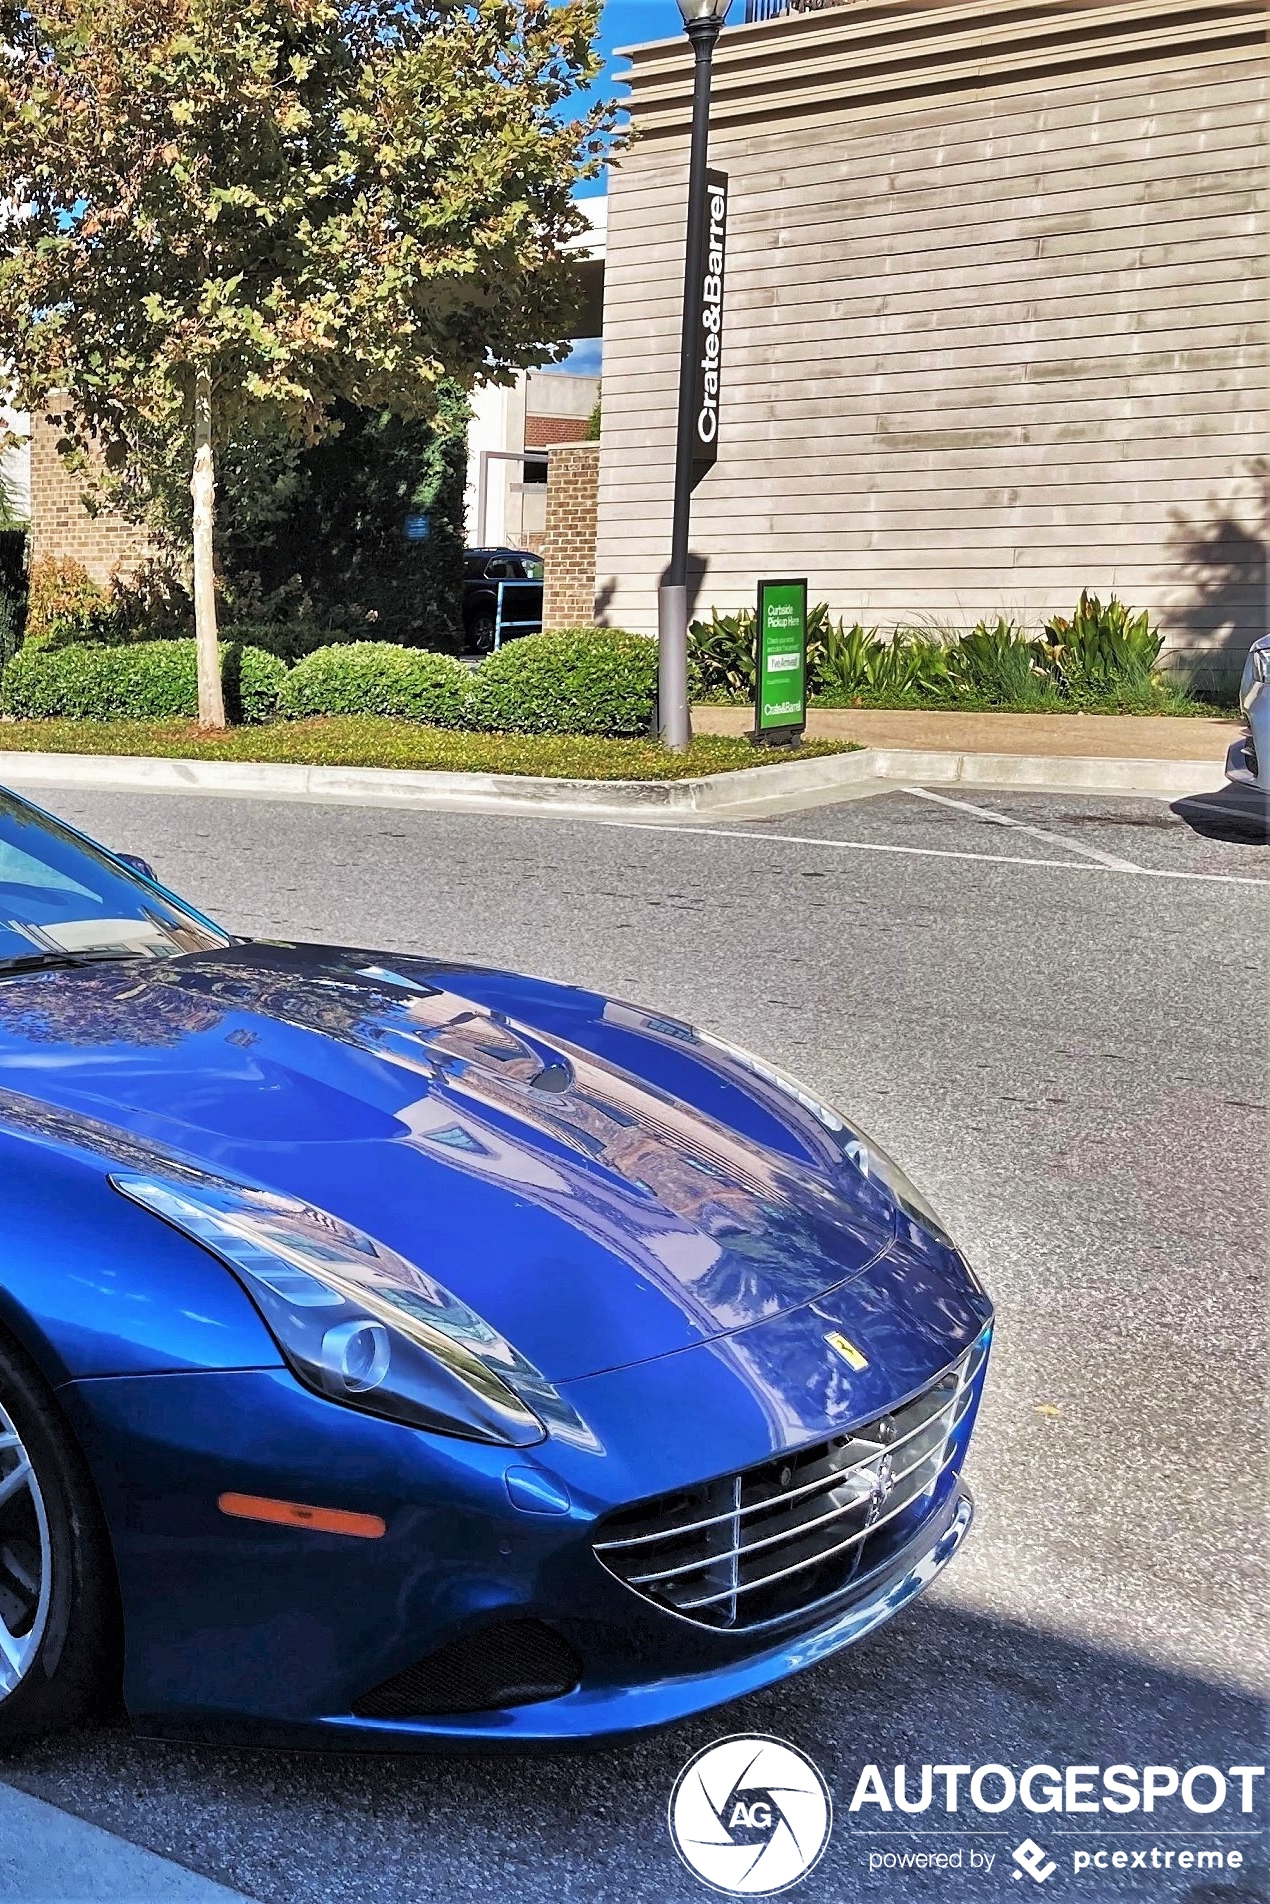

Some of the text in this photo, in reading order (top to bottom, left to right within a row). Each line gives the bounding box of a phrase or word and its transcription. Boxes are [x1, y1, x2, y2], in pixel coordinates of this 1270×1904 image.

[697, 184, 725, 443] Crate&Barrel
[767, 604, 794, 616] Curbside
[767, 616, 788, 629] Pickup
[764, 700, 801, 717] Crate&Barrel
